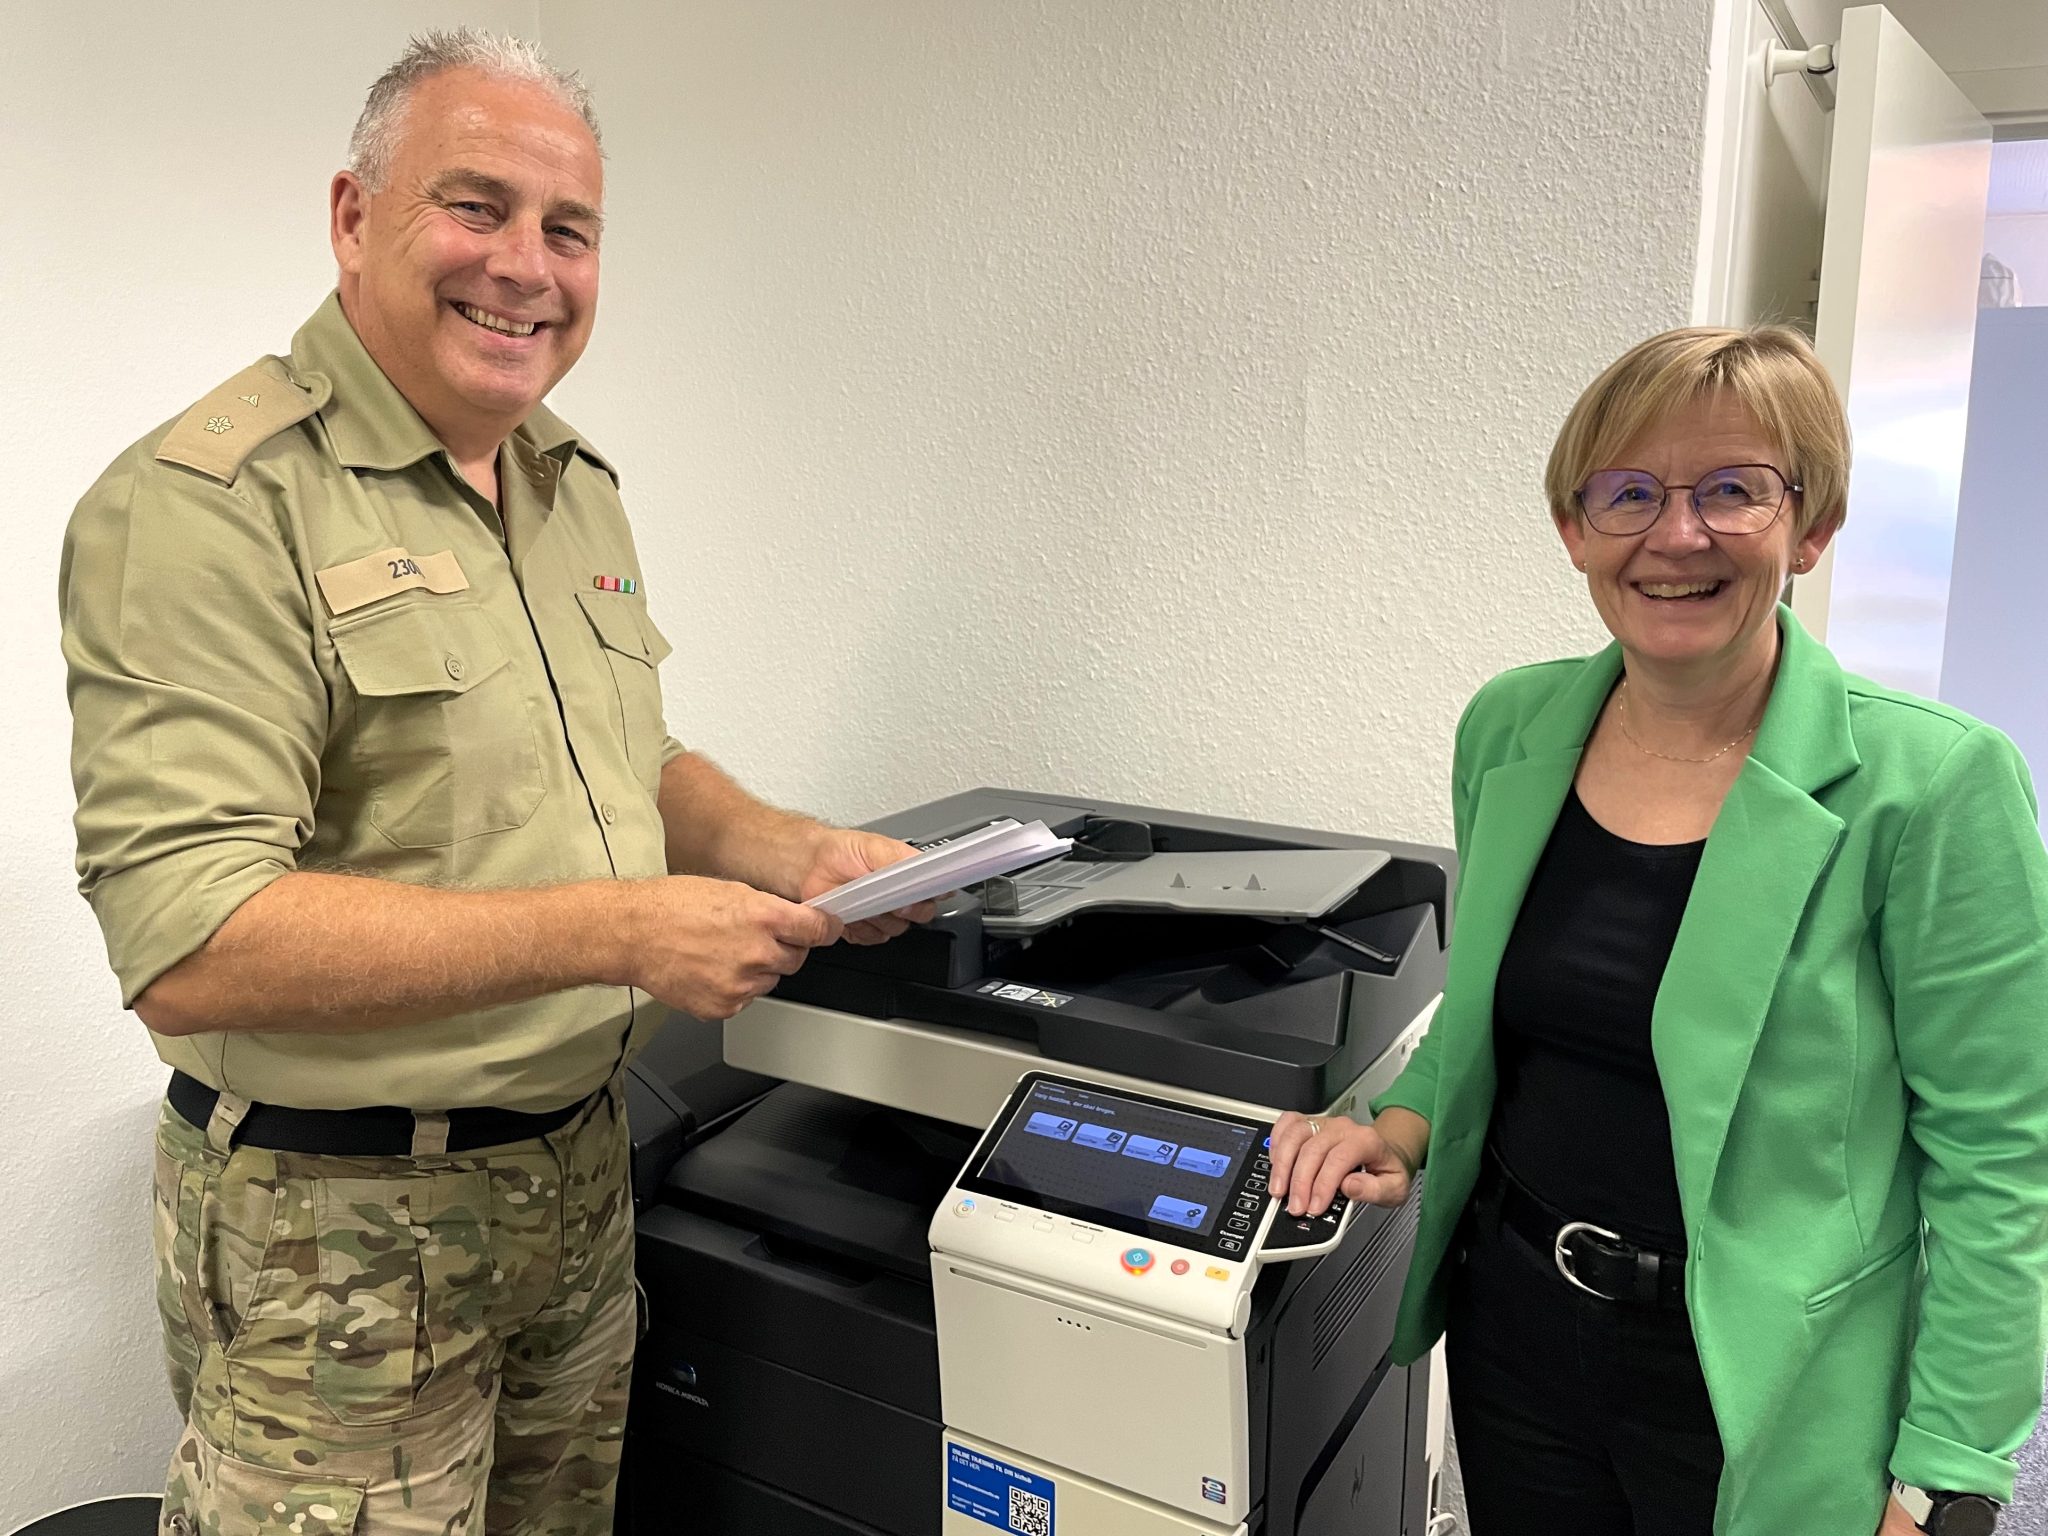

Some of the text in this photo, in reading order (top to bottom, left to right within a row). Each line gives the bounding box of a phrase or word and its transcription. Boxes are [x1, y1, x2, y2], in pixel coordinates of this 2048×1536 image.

[655, 1381, 710, 1408] KONICA MINOLTA
[951, 1448, 970, 1460] ONLINE
[951, 1454, 959, 1463] FÅ
[959, 1457, 969, 1467] DET
